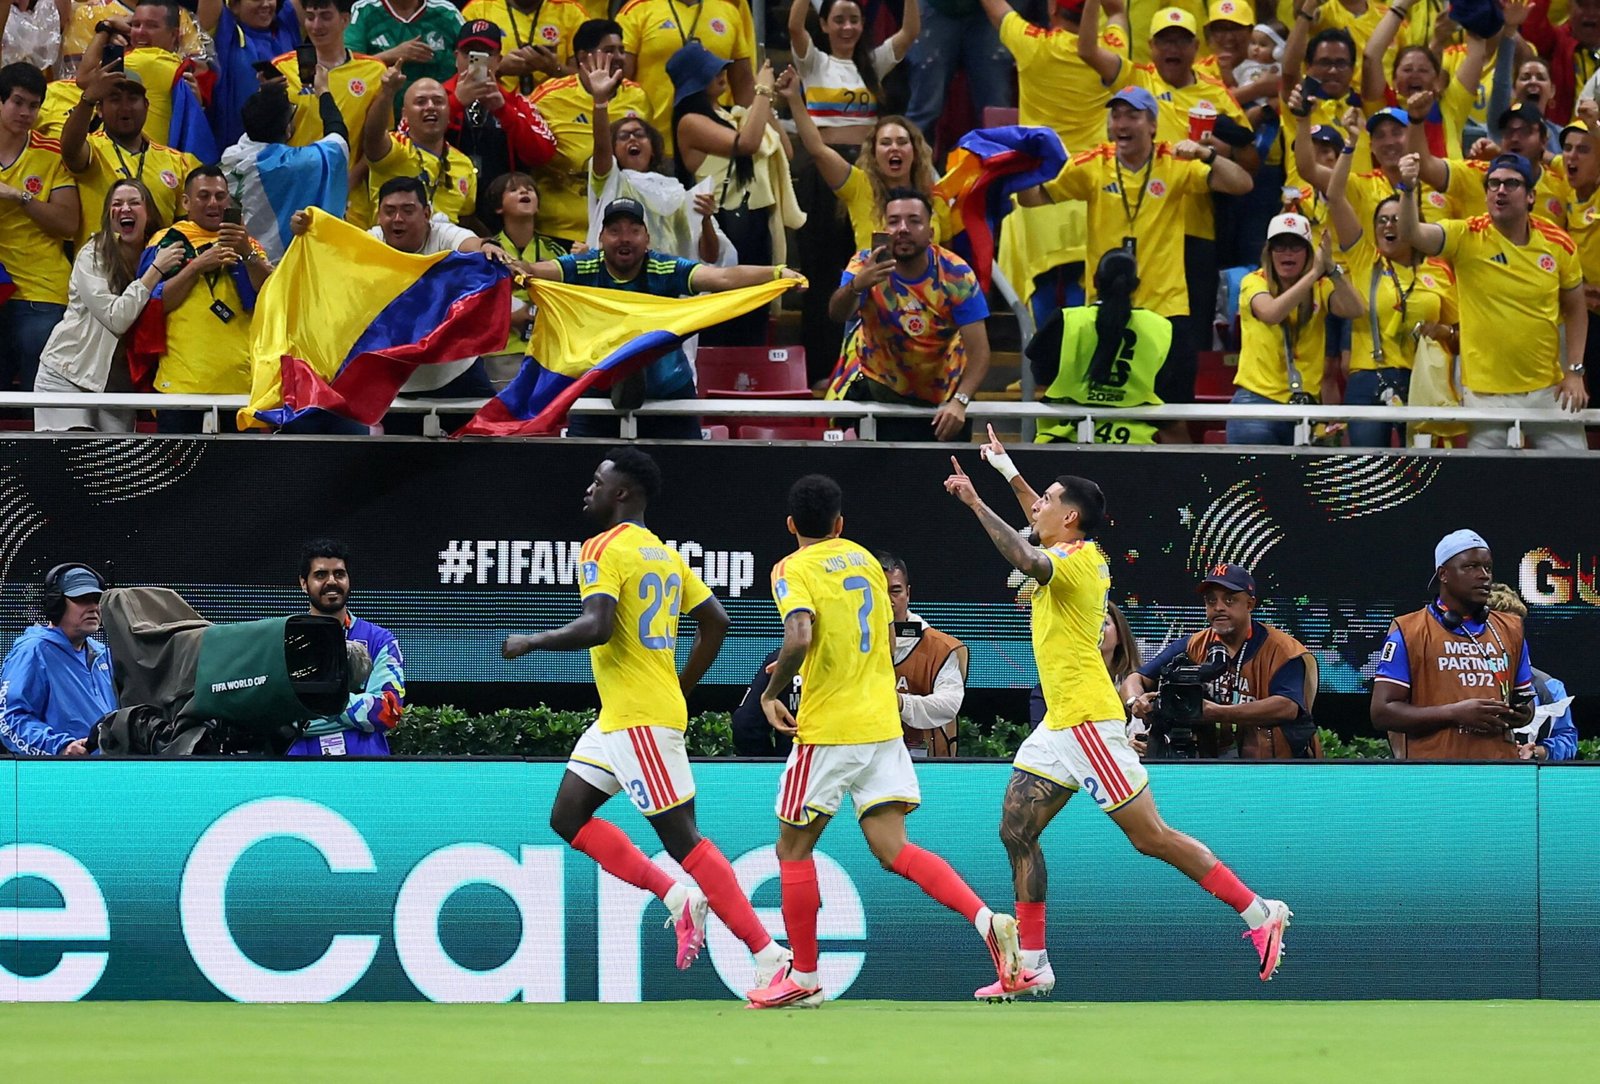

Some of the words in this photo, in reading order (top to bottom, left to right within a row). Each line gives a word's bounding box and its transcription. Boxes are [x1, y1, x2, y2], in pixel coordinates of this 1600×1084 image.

[438, 540, 753, 597] #FIFAWCup
[639, 572, 681, 650] 23
[843, 575, 873, 653] 7
[211, 682, 228, 693] FIFA
[227, 678, 253, 690] WORLD
[1458, 672, 1495, 687] 1972
[625, 779, 650, 809] 3
[179, 795, 867, 1003] Care
